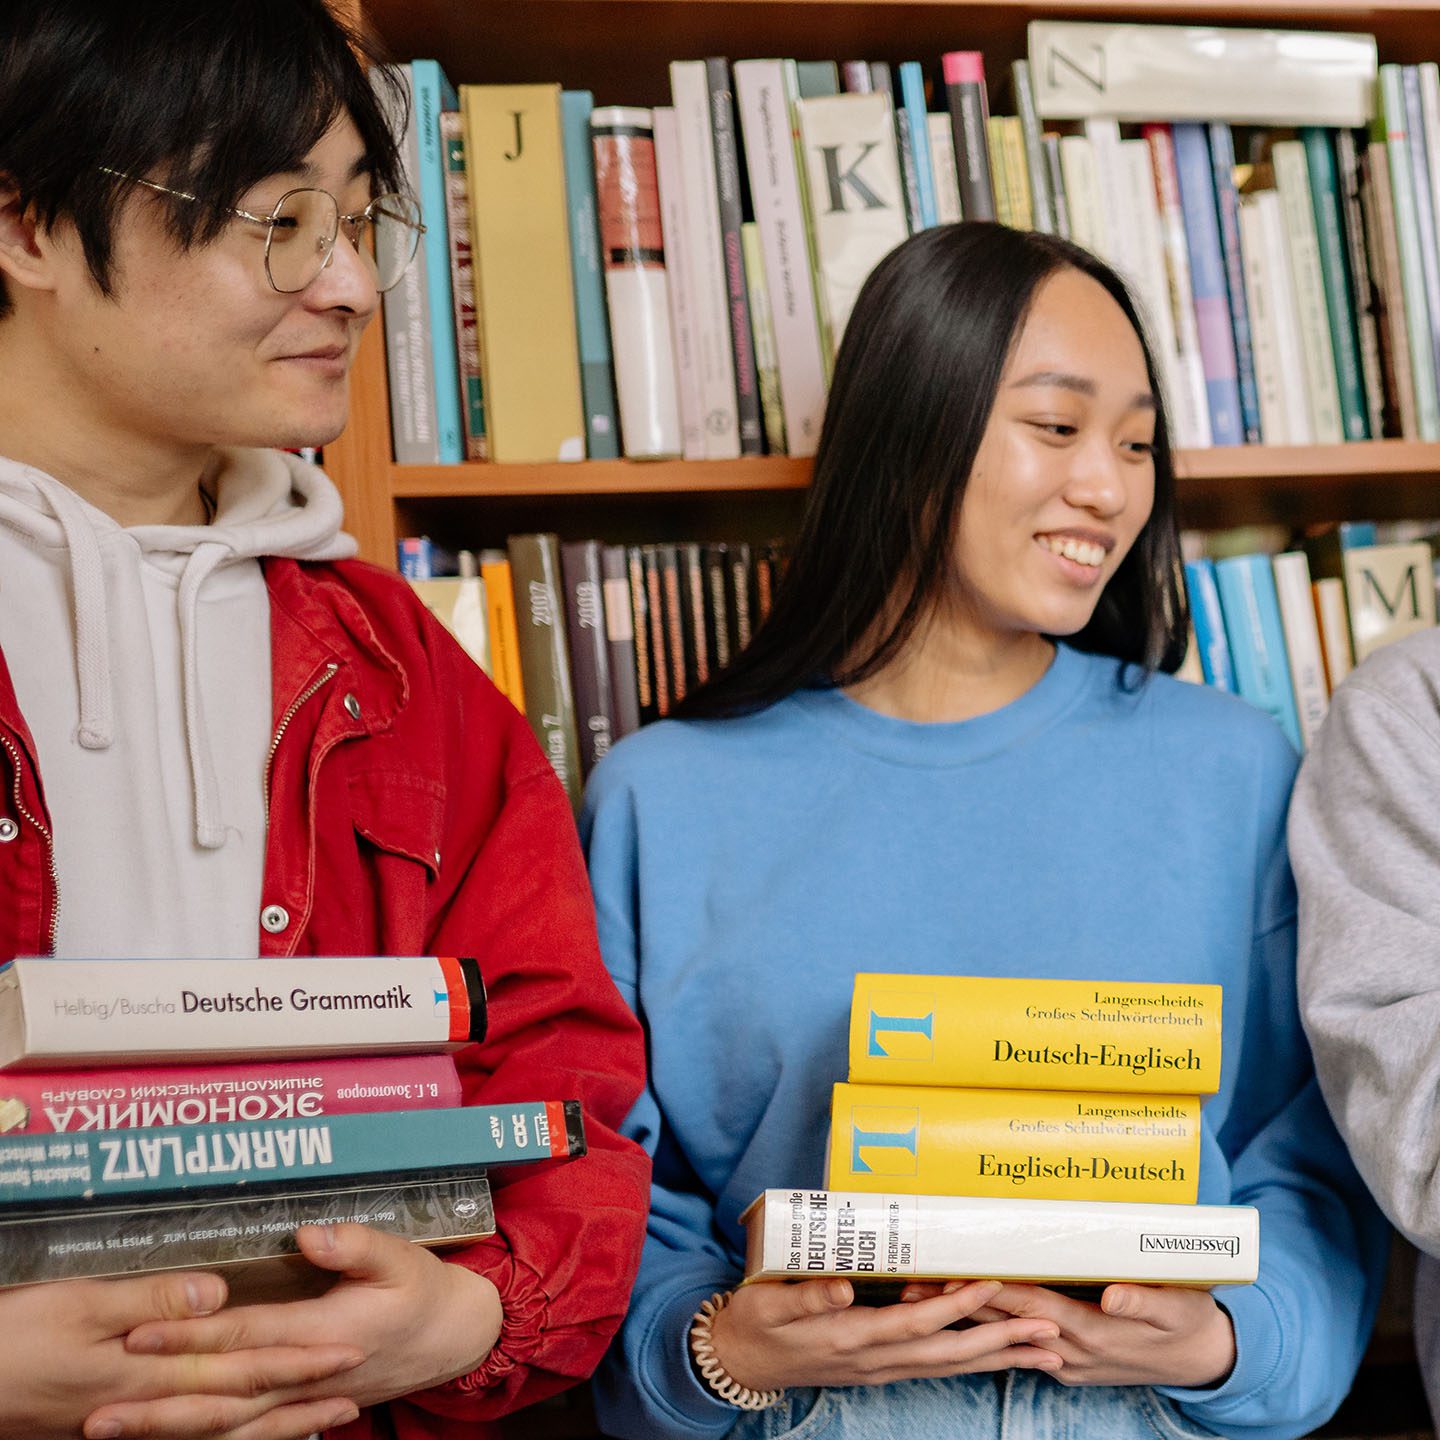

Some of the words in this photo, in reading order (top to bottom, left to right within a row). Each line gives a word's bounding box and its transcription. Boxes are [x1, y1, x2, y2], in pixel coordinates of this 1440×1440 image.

[504, 109, 528, 161] J
[814, 141, 889, 215] K
[1360, 566, 1421, 619] M
[53, 994, 175, 1019] Helbig/Buscha
[182, 988, 283, 1013] Deutsche
[290, 985, 413, 1012] Grammatik
[1026, 1006, 1076, 1021] Großes
[1080, 1008, 1204, 1026] Schulwörterbuch
[1094, 992, 1204, 1011] Langenscheidts
[993, 1039, 1201, 1075] Deutsch-Englisch
[41, 1085, 126, 1103] СЛОВАРЬ
[129, 1077, 323, 1101] ЭНЦИКЛОПЕДИЧЕСКИЙ
[337, 1083, 411, 1100] Золотогоров
[45, 1091, 324, 1133] ЭКОНОМИКА
[1008, 1119, 1060, 1134] Großes
[1064, 1121, 1187, 1138] Schulwörterbuch
[1077, 1104, 1187, 1120] Langenscheidts
[99, 1126, 332, 1181] MARKTPLATZ
[977, 1153, 1186, 1185] Englisch-Deutsch
[48, 1240, 104, 1256] MEMORIA
[106, 1235, 153, 1251] SILESIAE
[163, 1231, 188, 1244] ZUM
[189, 1226, 243, 1242] GEDENKEN
[244, 1224, 260, 1236] AN
[262, 1221, 299, 1234] MARIAN
[791, 1223, 802, 1248] neue
[808, 1193, 828, 1270] DEUTSCHE
[832, 1201, 856, 1271] WÖRTER-
[787, 1251, 801, 1270] Das
[857, 1230, 877, 1272] BUCH
[900, 1243, 911, 1265] BUCH
